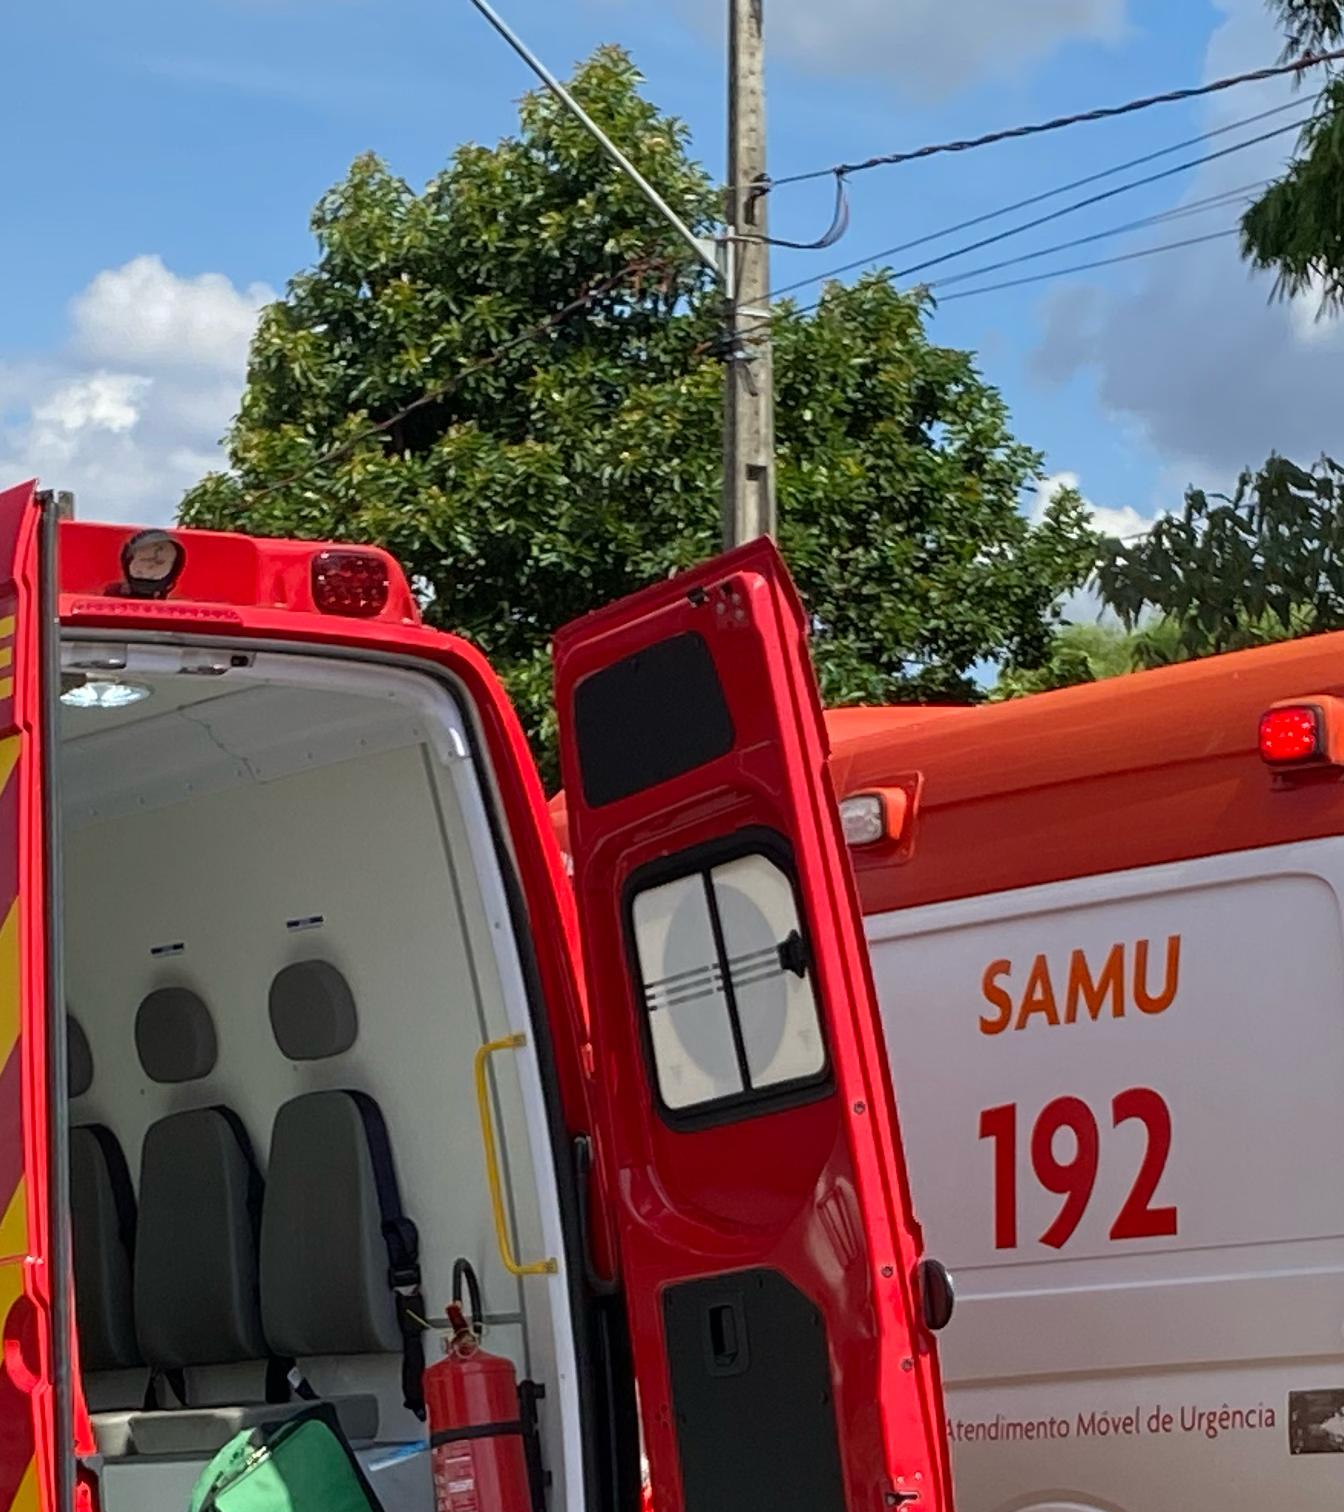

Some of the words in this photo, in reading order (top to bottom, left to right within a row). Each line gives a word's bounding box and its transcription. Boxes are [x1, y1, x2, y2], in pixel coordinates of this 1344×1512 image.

[979, 934, 1181, 1036] SAMU
[978, 1087, 1178, 1250] 192
[1076, 1405, 1140, 1437] Móvel
[1147, 1404, 1173, 1433] de
[1181, 1402, 1275, 1439] Urgência
